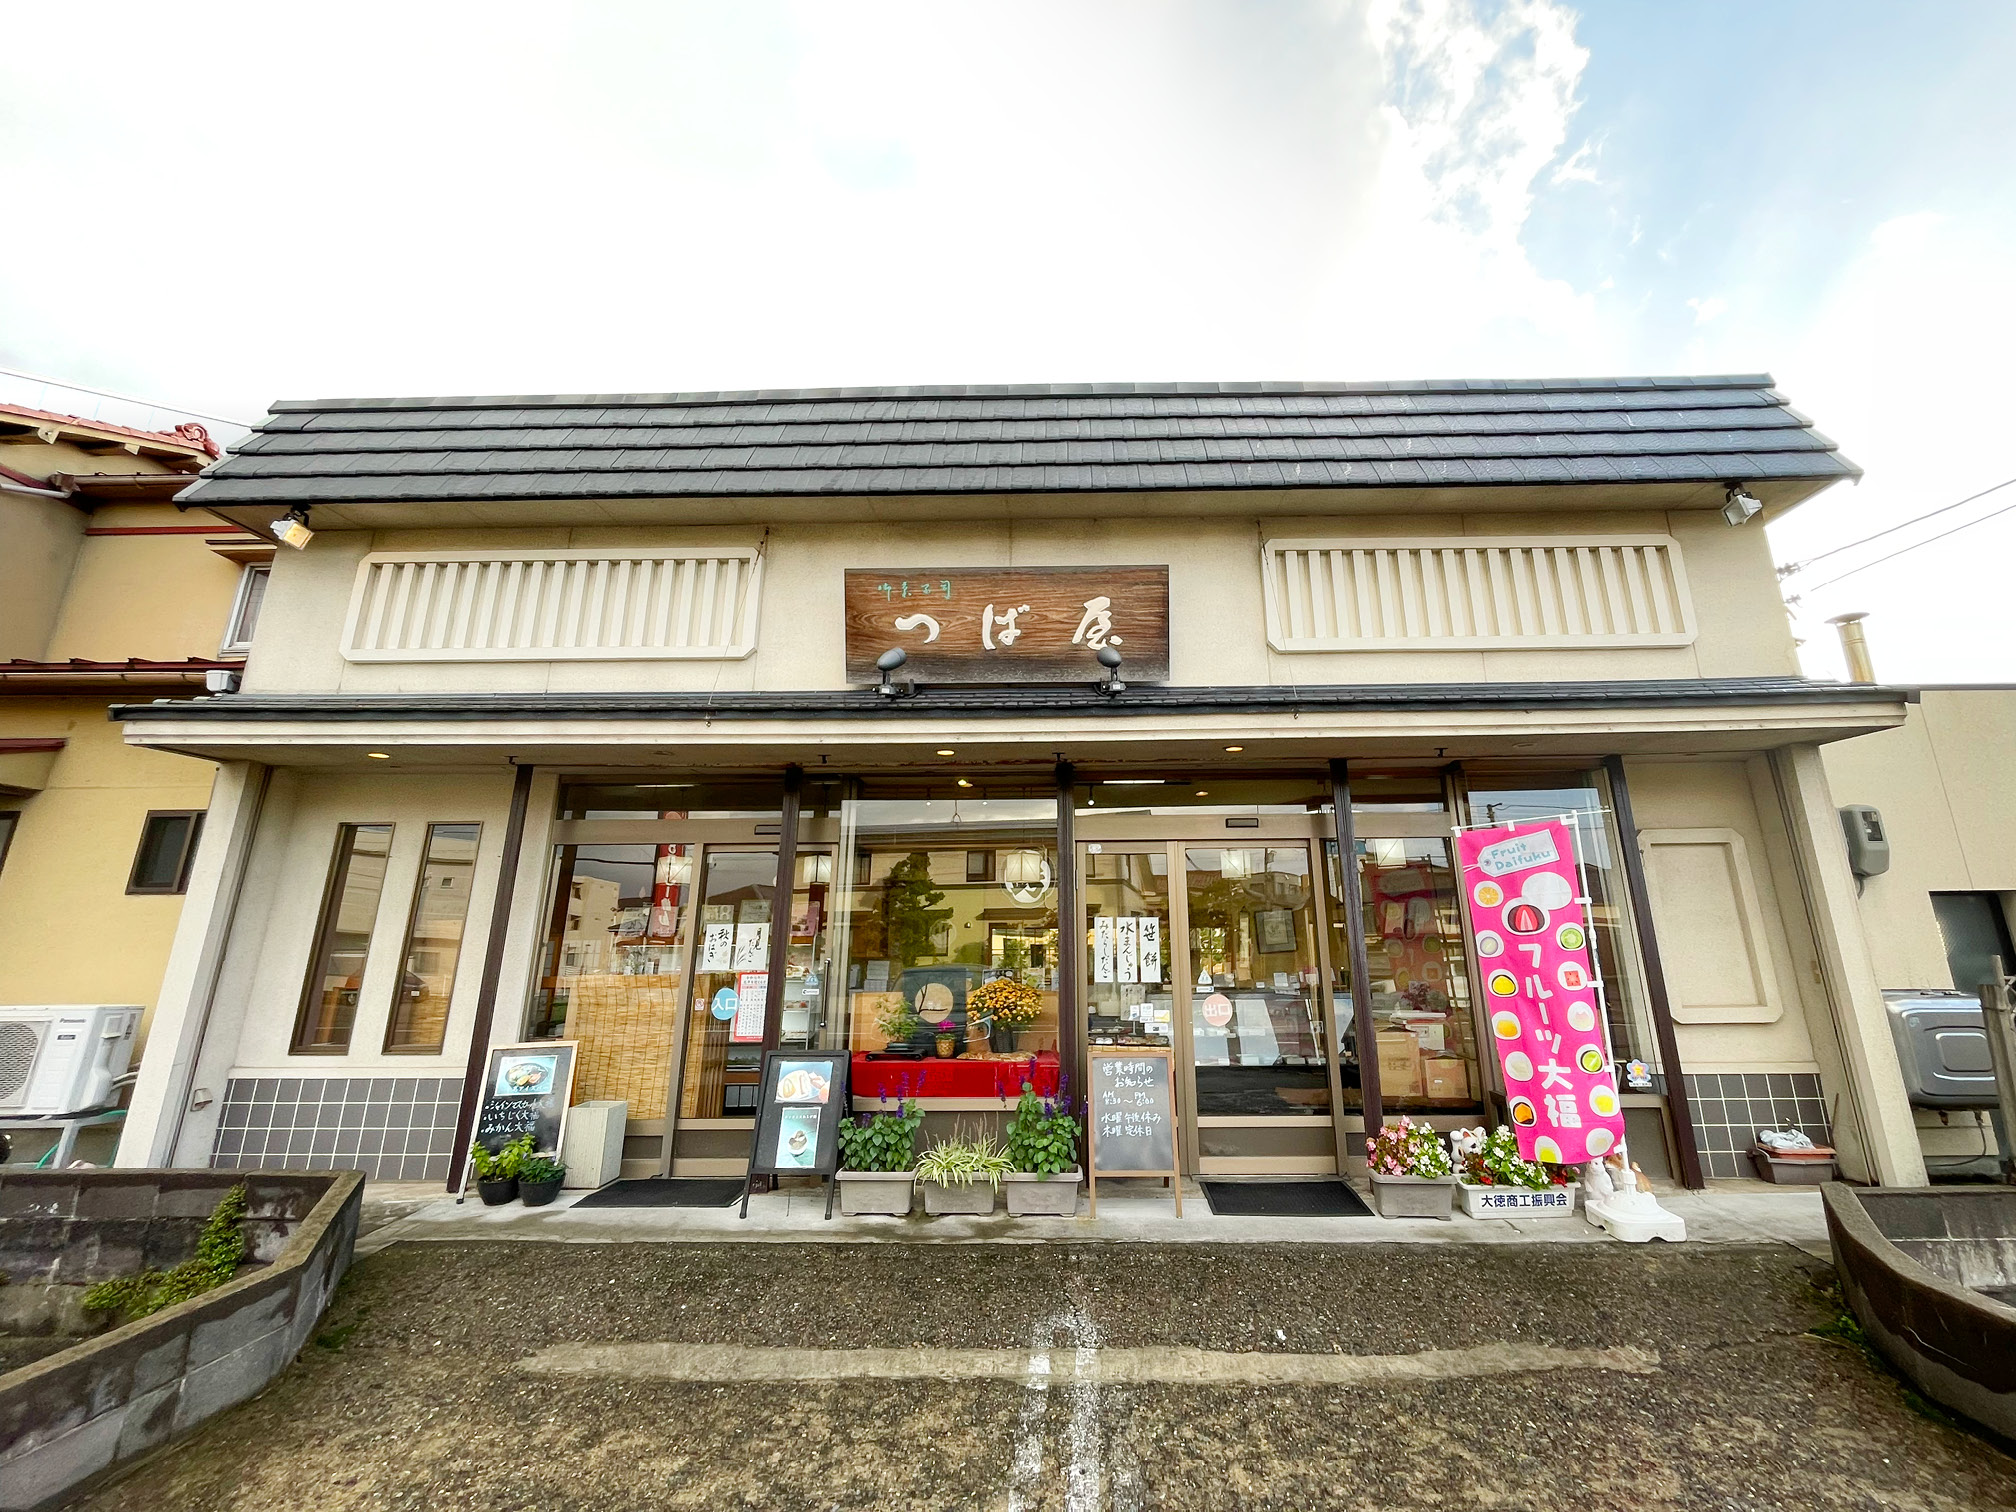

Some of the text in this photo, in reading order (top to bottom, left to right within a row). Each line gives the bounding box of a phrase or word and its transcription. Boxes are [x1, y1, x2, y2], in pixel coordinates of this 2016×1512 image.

[894, 596, 1124, 650] つば屋
[1491, 842, 1527, 859] Fruit
[1494, 850, 1551, 871] Daifuku
[1120, 921, 1135, 981] 水まんじゅう
[712, 998, 738, 1012] 入口
[1205, 1003, 1231, 1018] 出口
[1518, 943, 1582, 1129] フルーツ大福
[1102, 1061, 1153, 1076] 営業時間の
[1115, 1076, 1155, 1088] お知らせ
[1481, 1193, 1567, 1208] 大徳商工振興会
